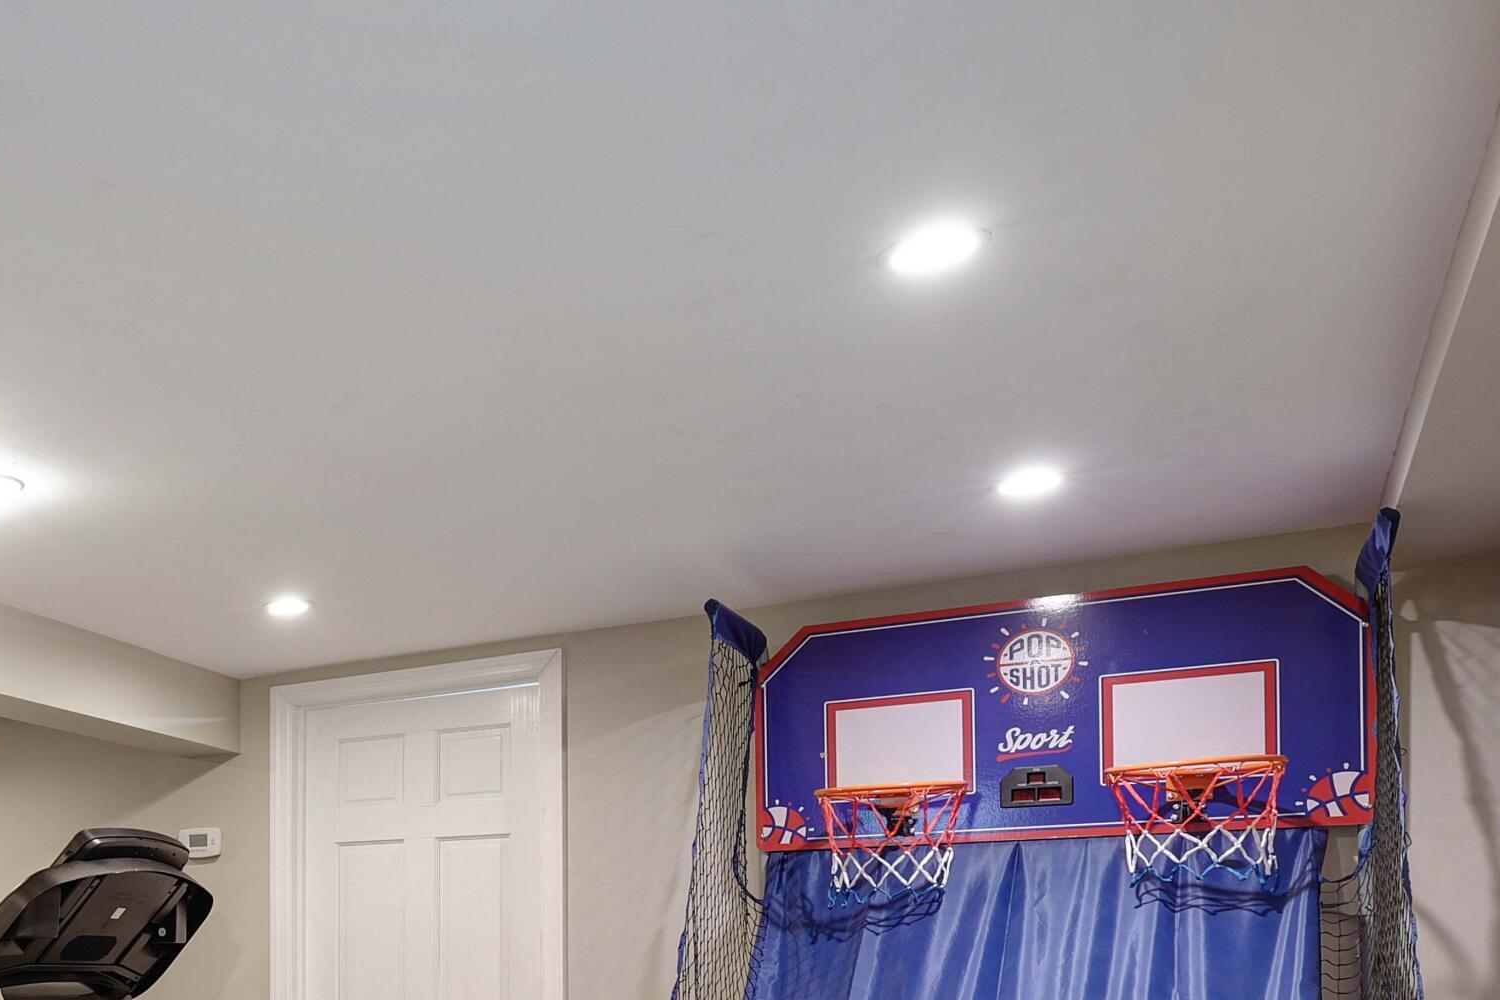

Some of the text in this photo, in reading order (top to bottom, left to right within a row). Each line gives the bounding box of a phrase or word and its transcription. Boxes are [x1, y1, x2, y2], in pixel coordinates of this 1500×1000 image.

[1009, 633, 1062, 660] POP
[1009, 664, 1062, 690] SHOT
[998, 725, 1075, 753] Sport
